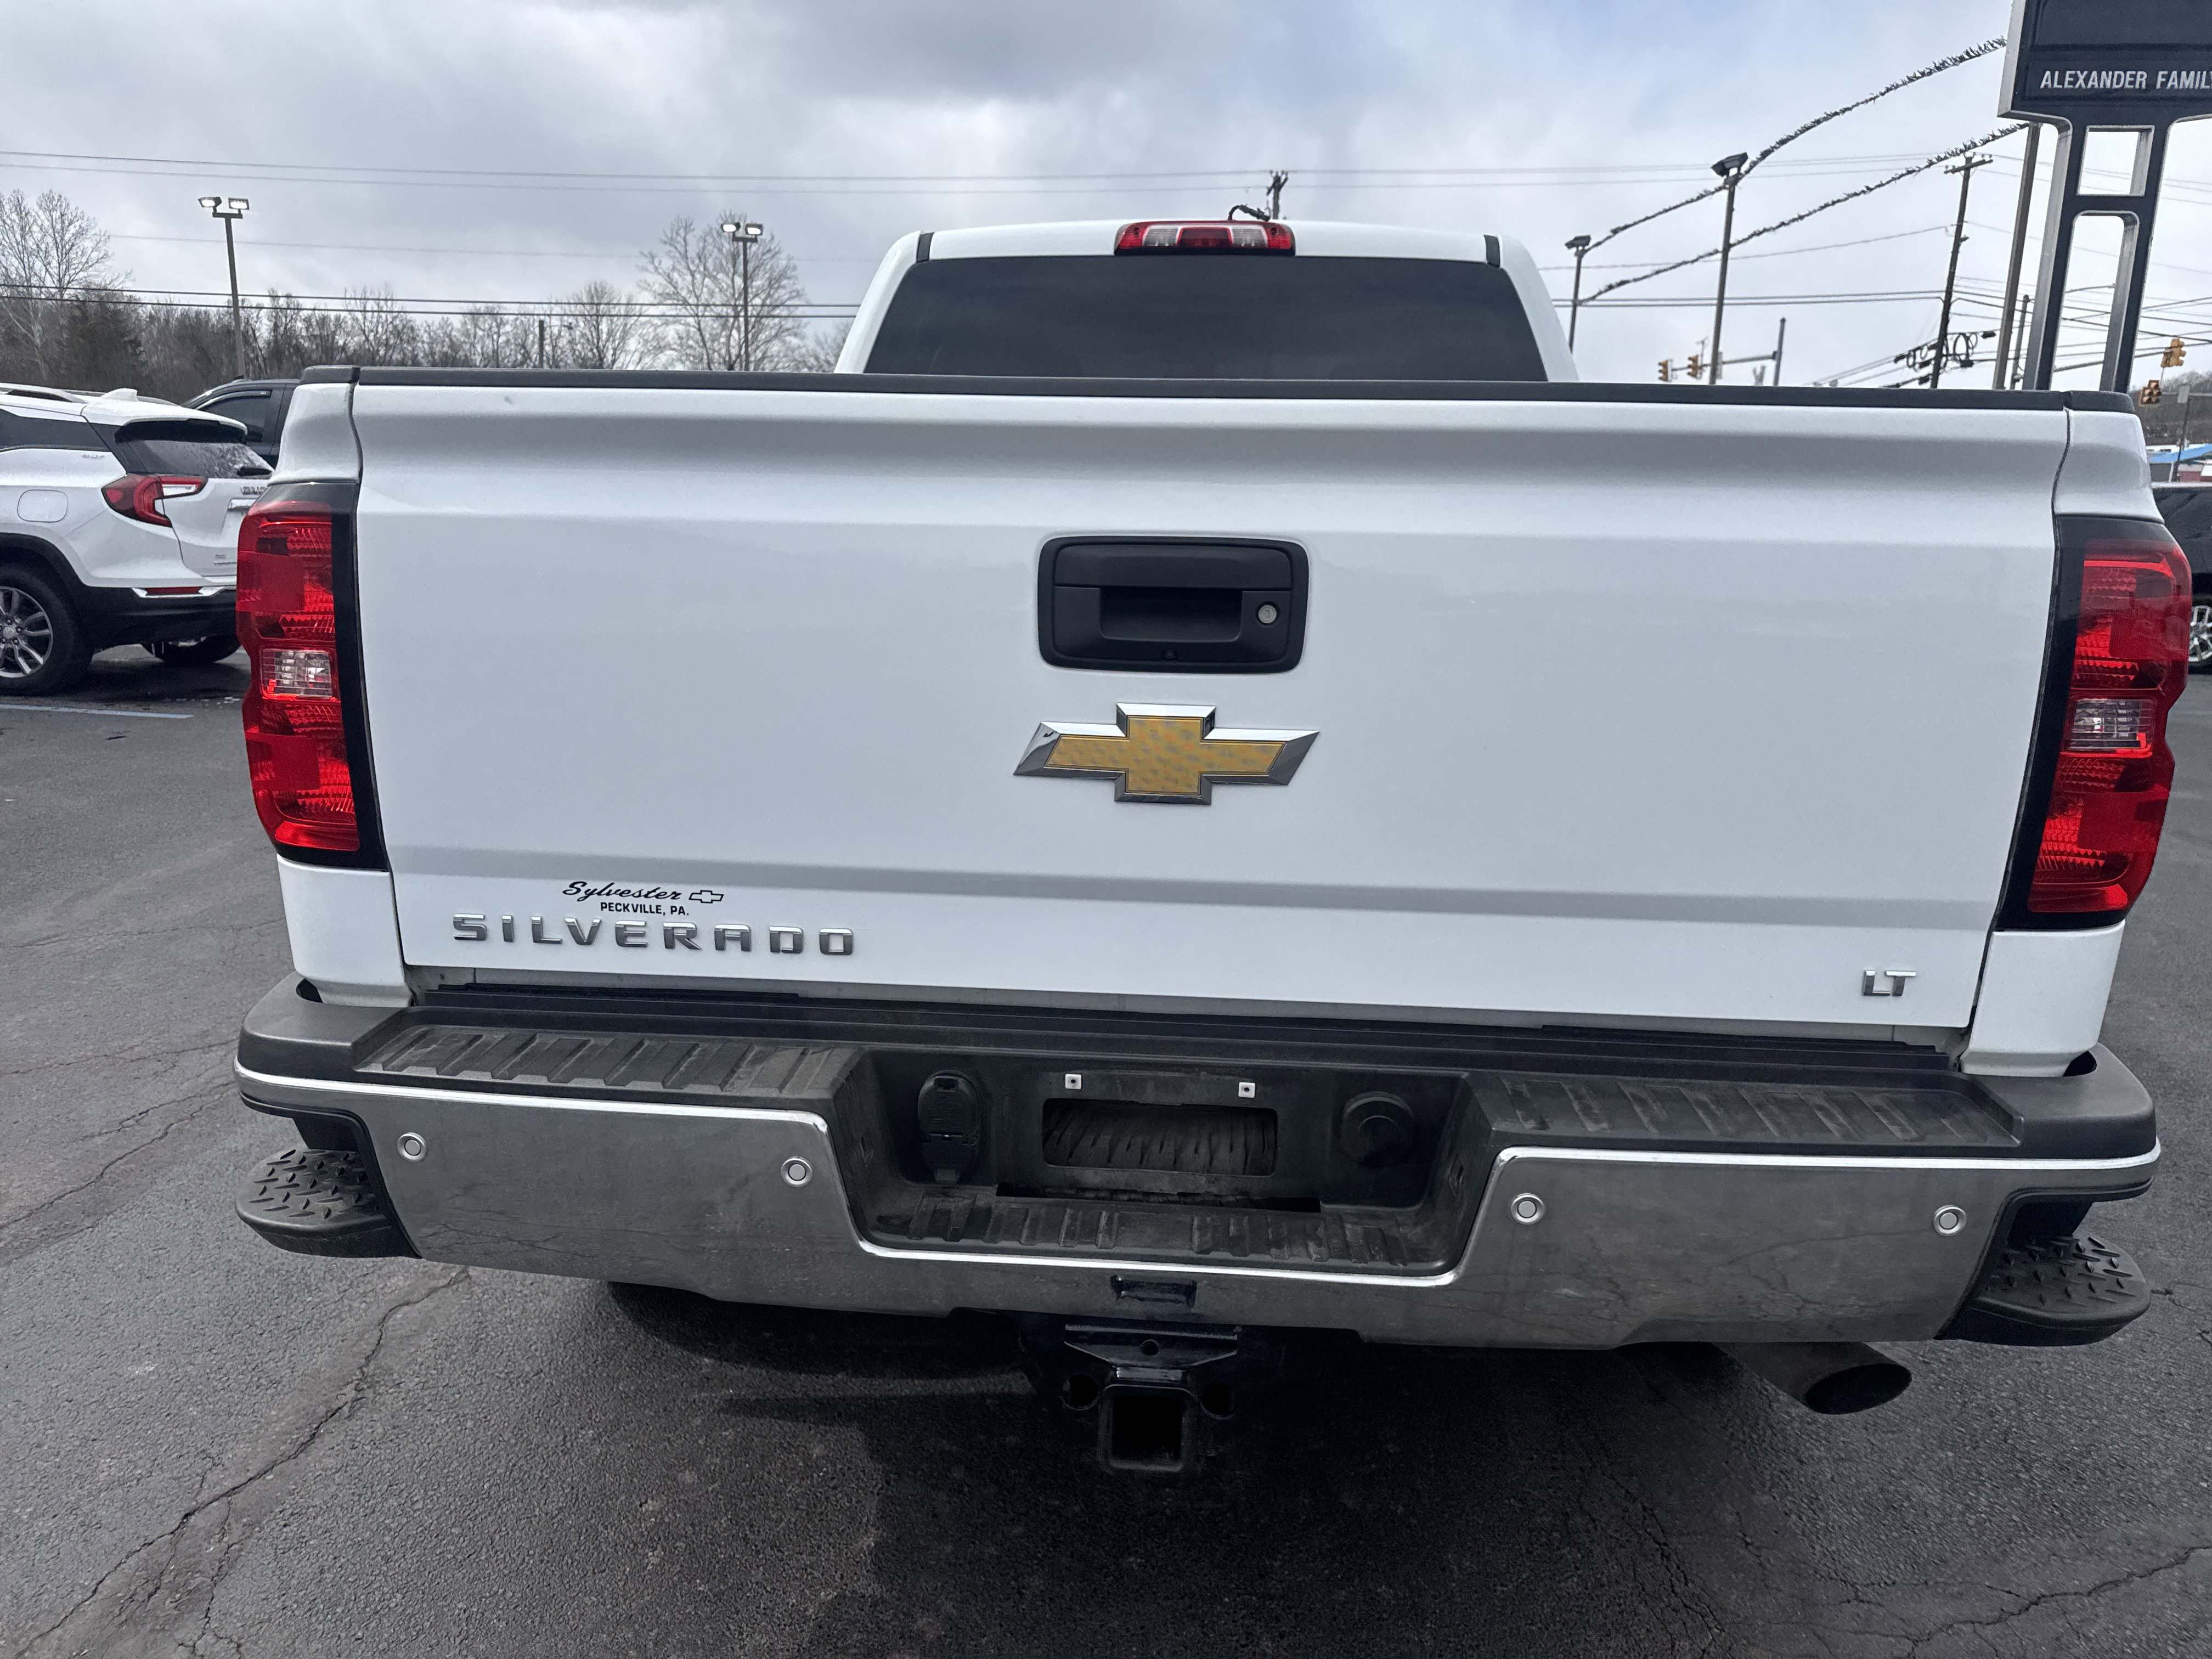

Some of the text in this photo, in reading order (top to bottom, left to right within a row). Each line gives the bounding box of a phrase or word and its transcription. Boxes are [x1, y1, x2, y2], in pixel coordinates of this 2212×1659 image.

[2040, 70, 2212, 89] ALEXANDER FAMIL
[562, 881, 682, 902] Sylvester
[600, 902, 689, 916] PECKVILLE, PA.
[453, 913, 854, 956] SILVERADO
[1862, 969, 1916, 997] LT
